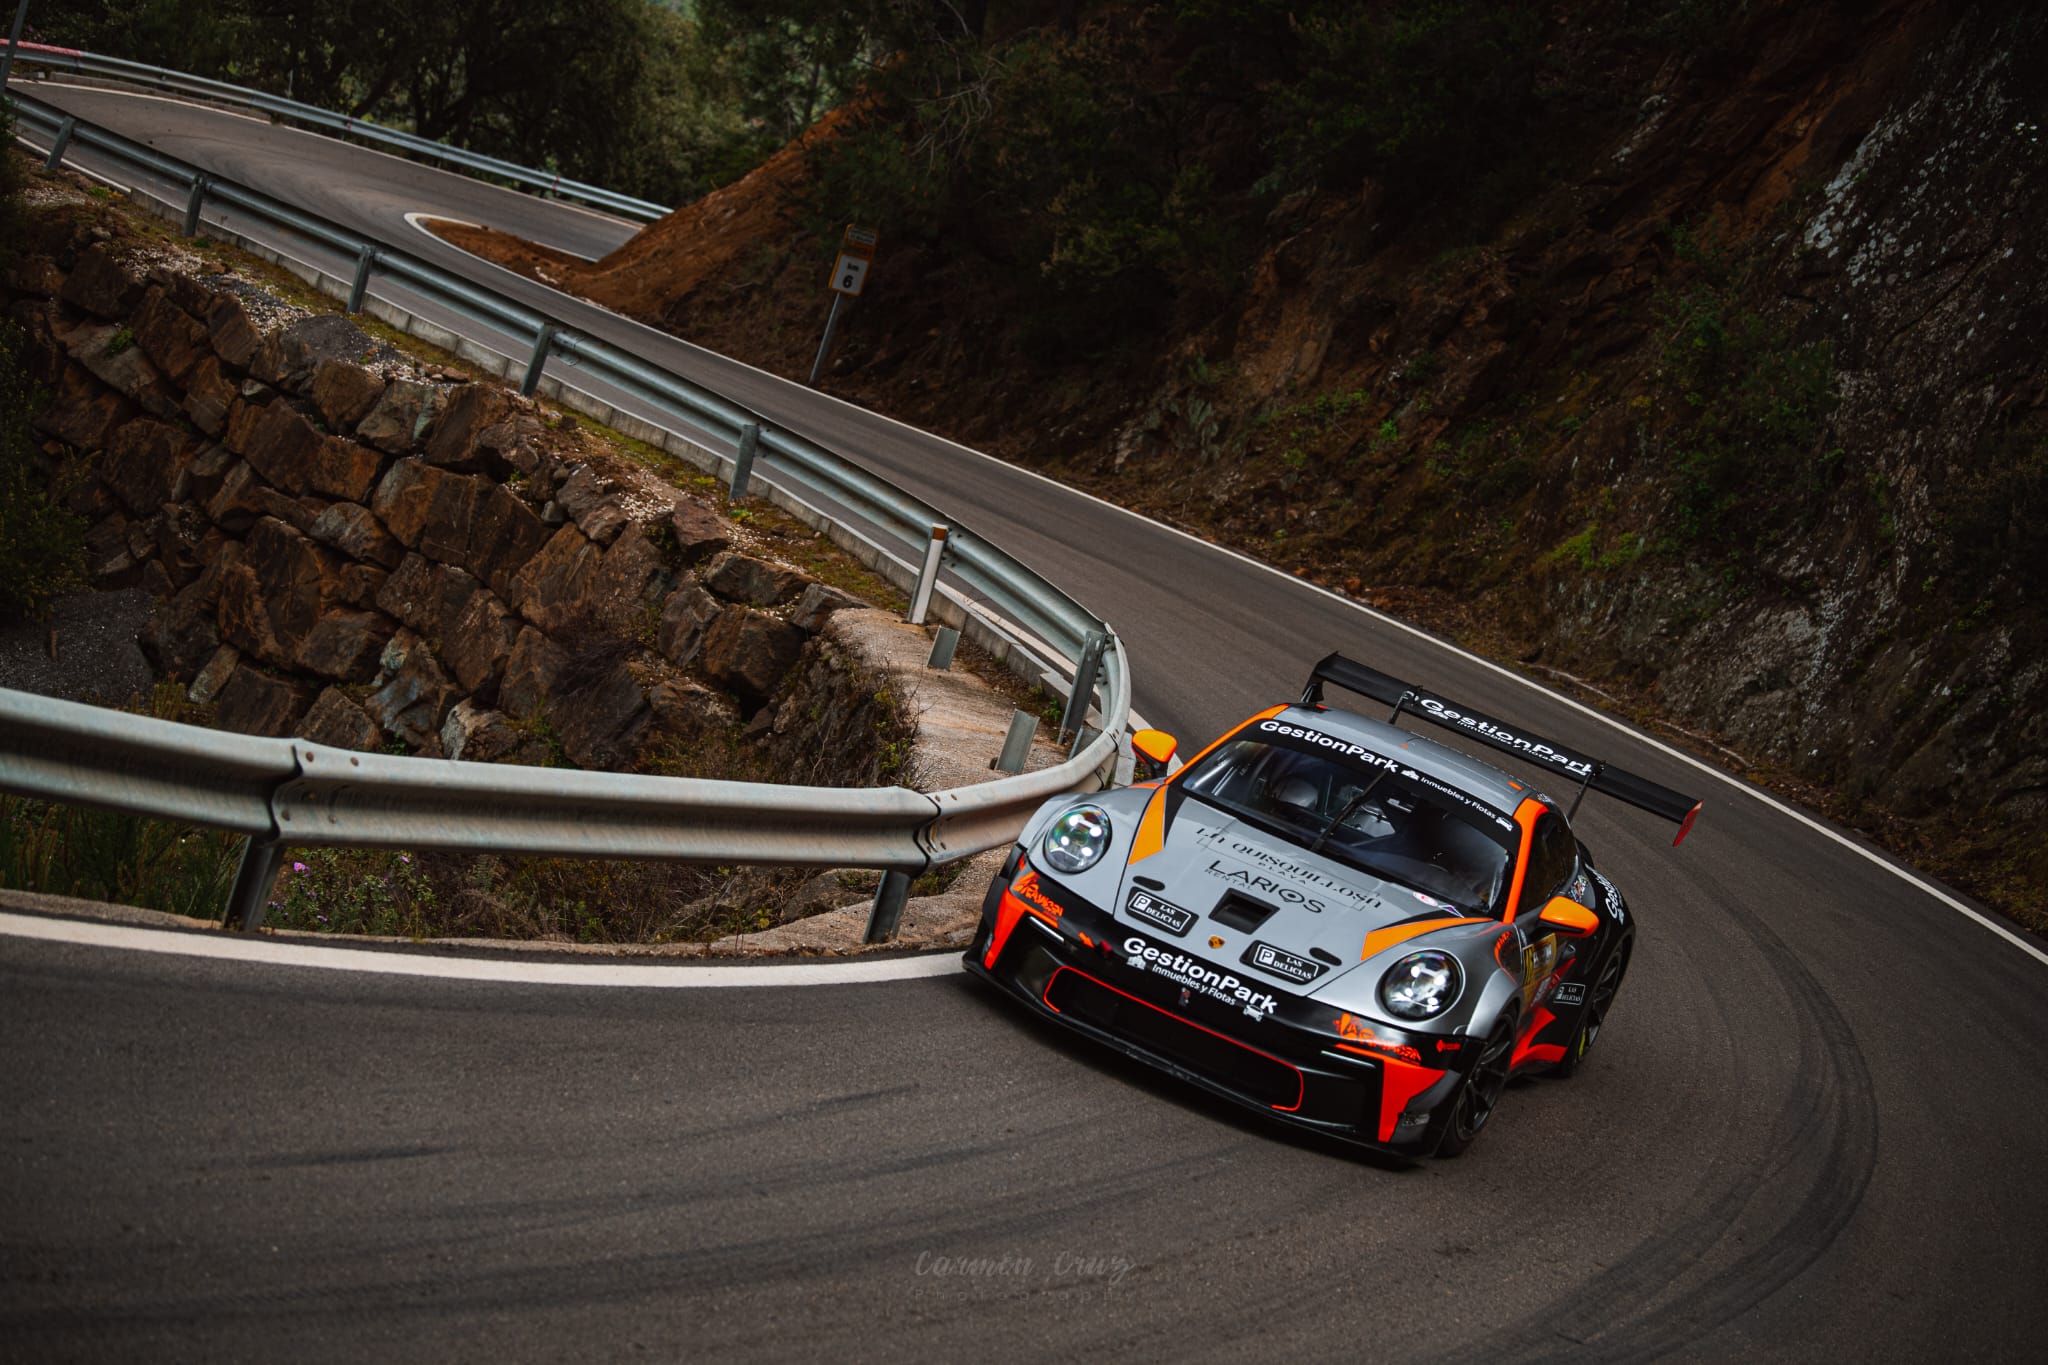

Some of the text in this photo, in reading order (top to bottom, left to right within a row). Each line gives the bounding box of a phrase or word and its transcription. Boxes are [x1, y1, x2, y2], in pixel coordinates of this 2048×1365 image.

[843, 275, 853, 288] 6
[1259, 720, 1400, 773] GestionPark
[1420, 776, 1466, 802] Inmuebles
[1472, 800, 1498, 821] Flotas
[1204, 867, 1253, 891] RENTAL
[1258, 861, 1307, 885] PLAYA
[1208, 860, 1327, 914] LARIOS
[1145, 907, 1183, 929] DELICIAS
[1158, 904, 1177, 915] LAS
[1273, 960, 1313, 980] DELICIAS
[1286, 956, 1303, 968] LAS
[1123, 937, 1278, 1015] GestionPark
[1151, 963, 1236, 1006] Inmuebles y Flotas
